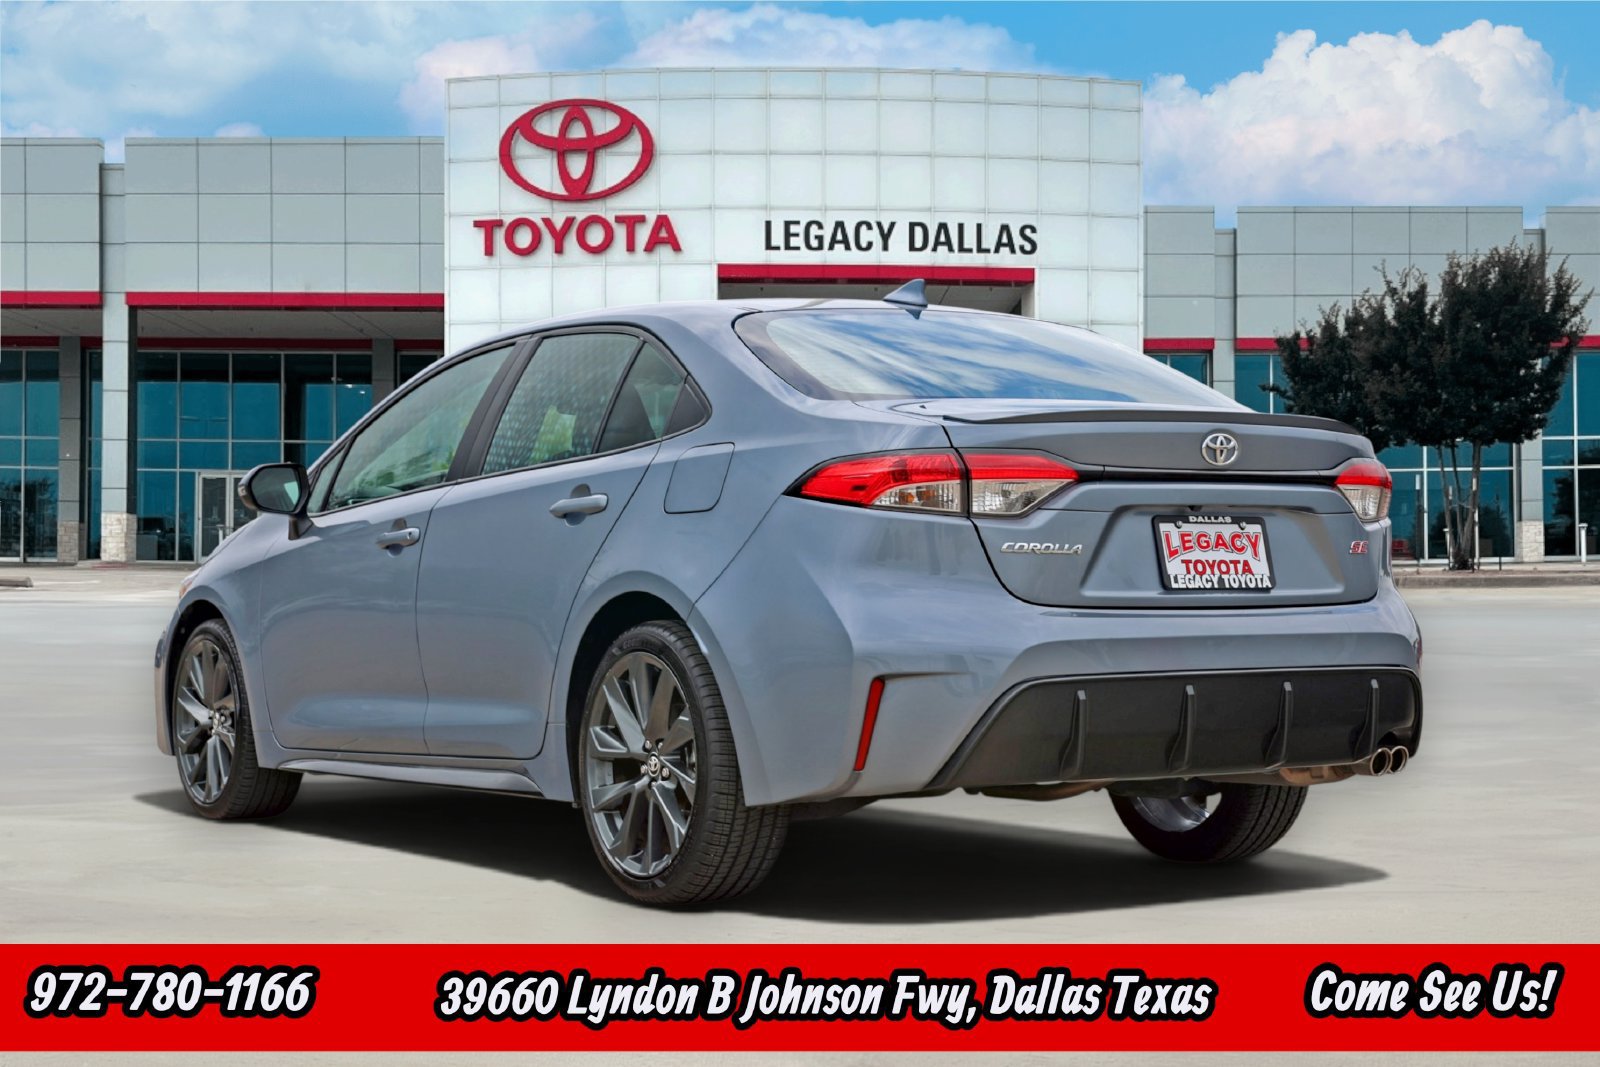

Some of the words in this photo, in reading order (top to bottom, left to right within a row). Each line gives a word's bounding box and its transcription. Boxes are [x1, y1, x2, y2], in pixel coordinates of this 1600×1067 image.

[473, 214, 682, 257] TOYOTA
[764, 220, 897, 253] LEGACY
[908, 221, 1039, 255] DALLAS
[1188, 515, 1232, 523] DALLAS
[1000, 542, 1083, 555] COROLLA
[1162, 530, 1262, 562] LEGACY
[1349, 540, 1369, 554] SE
[1180, 559, 1255, 576] TOYOTA
[1169, 574, 1219, 589] LEGACY
[1221, 574, 1273, 589] TOYOTA
